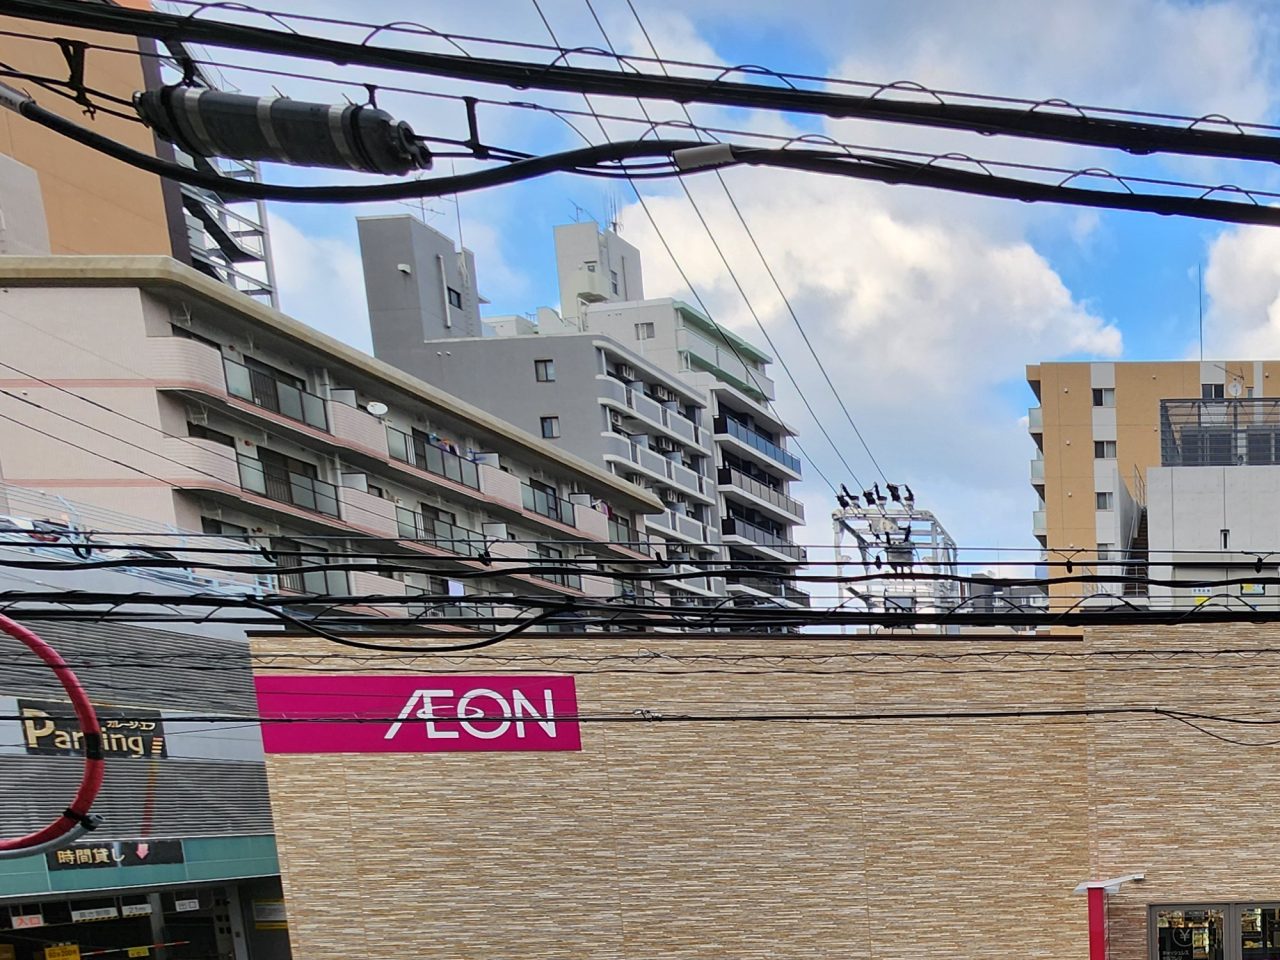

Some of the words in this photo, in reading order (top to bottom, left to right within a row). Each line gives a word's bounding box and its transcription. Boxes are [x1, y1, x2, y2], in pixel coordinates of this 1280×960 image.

[22, 708, 145, 759] Paring
[57, 848, 125, 865] 時間貸し
